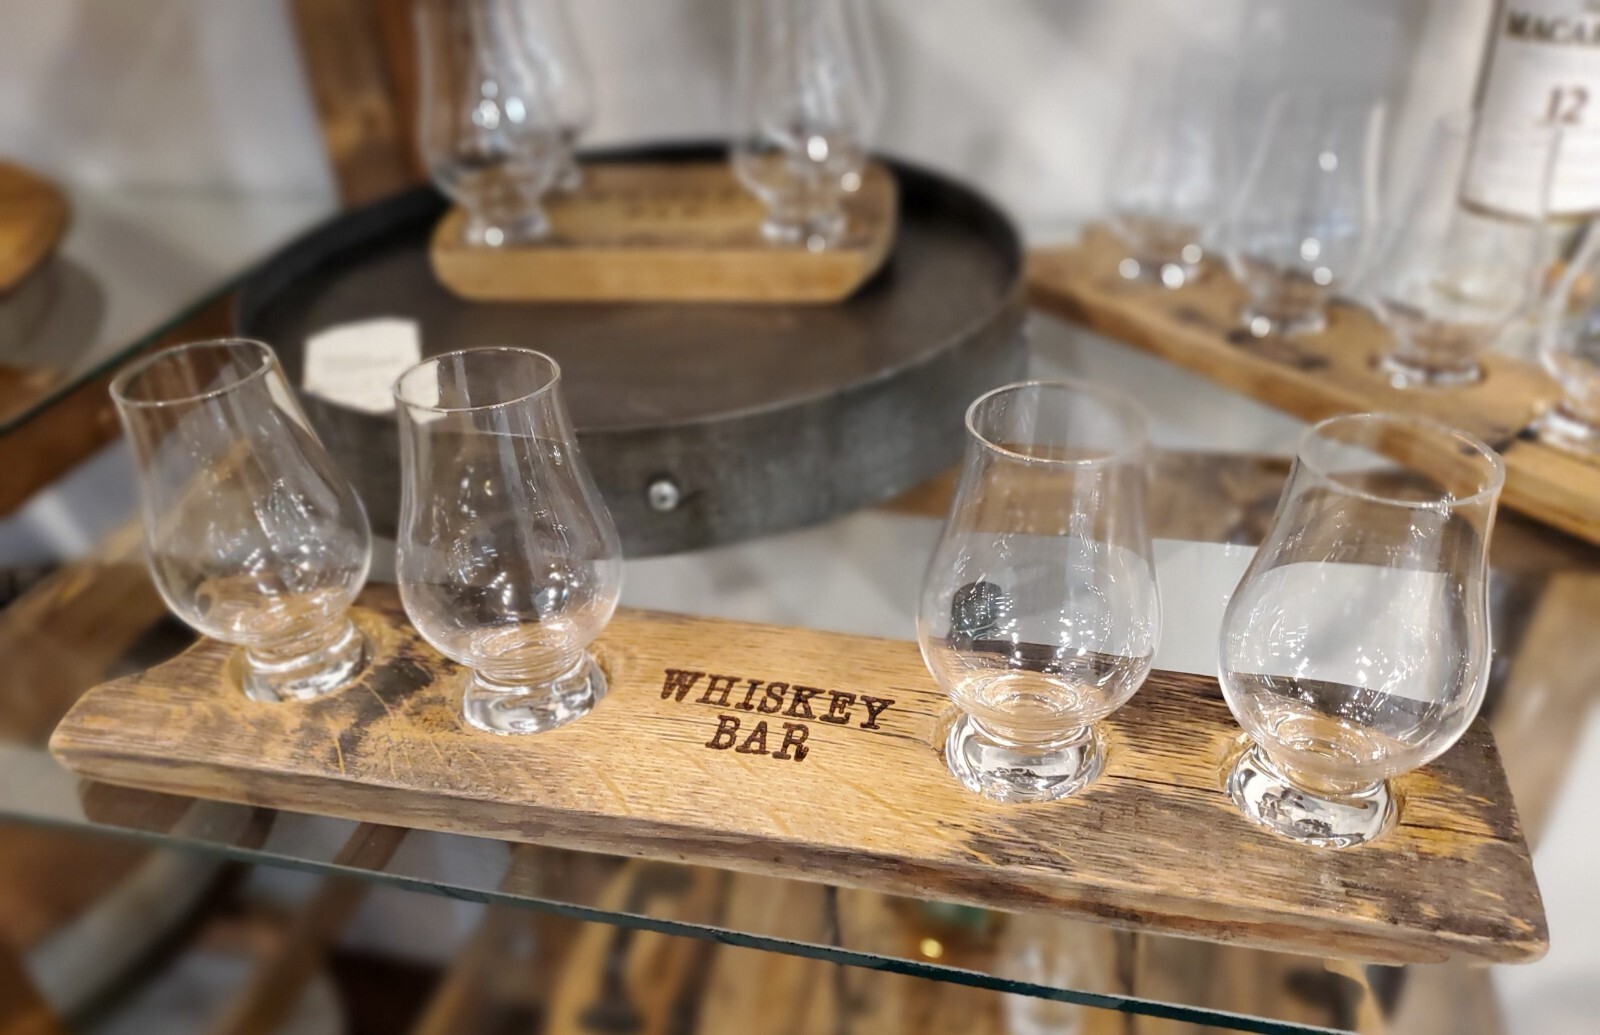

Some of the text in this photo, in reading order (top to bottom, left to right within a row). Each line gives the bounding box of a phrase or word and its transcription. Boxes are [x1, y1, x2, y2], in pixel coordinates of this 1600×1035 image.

[1542, 85, 1590, 127] 12
[660, 668, 896, 730] WHISKEY
[705, 714, 809, 762] BAR
